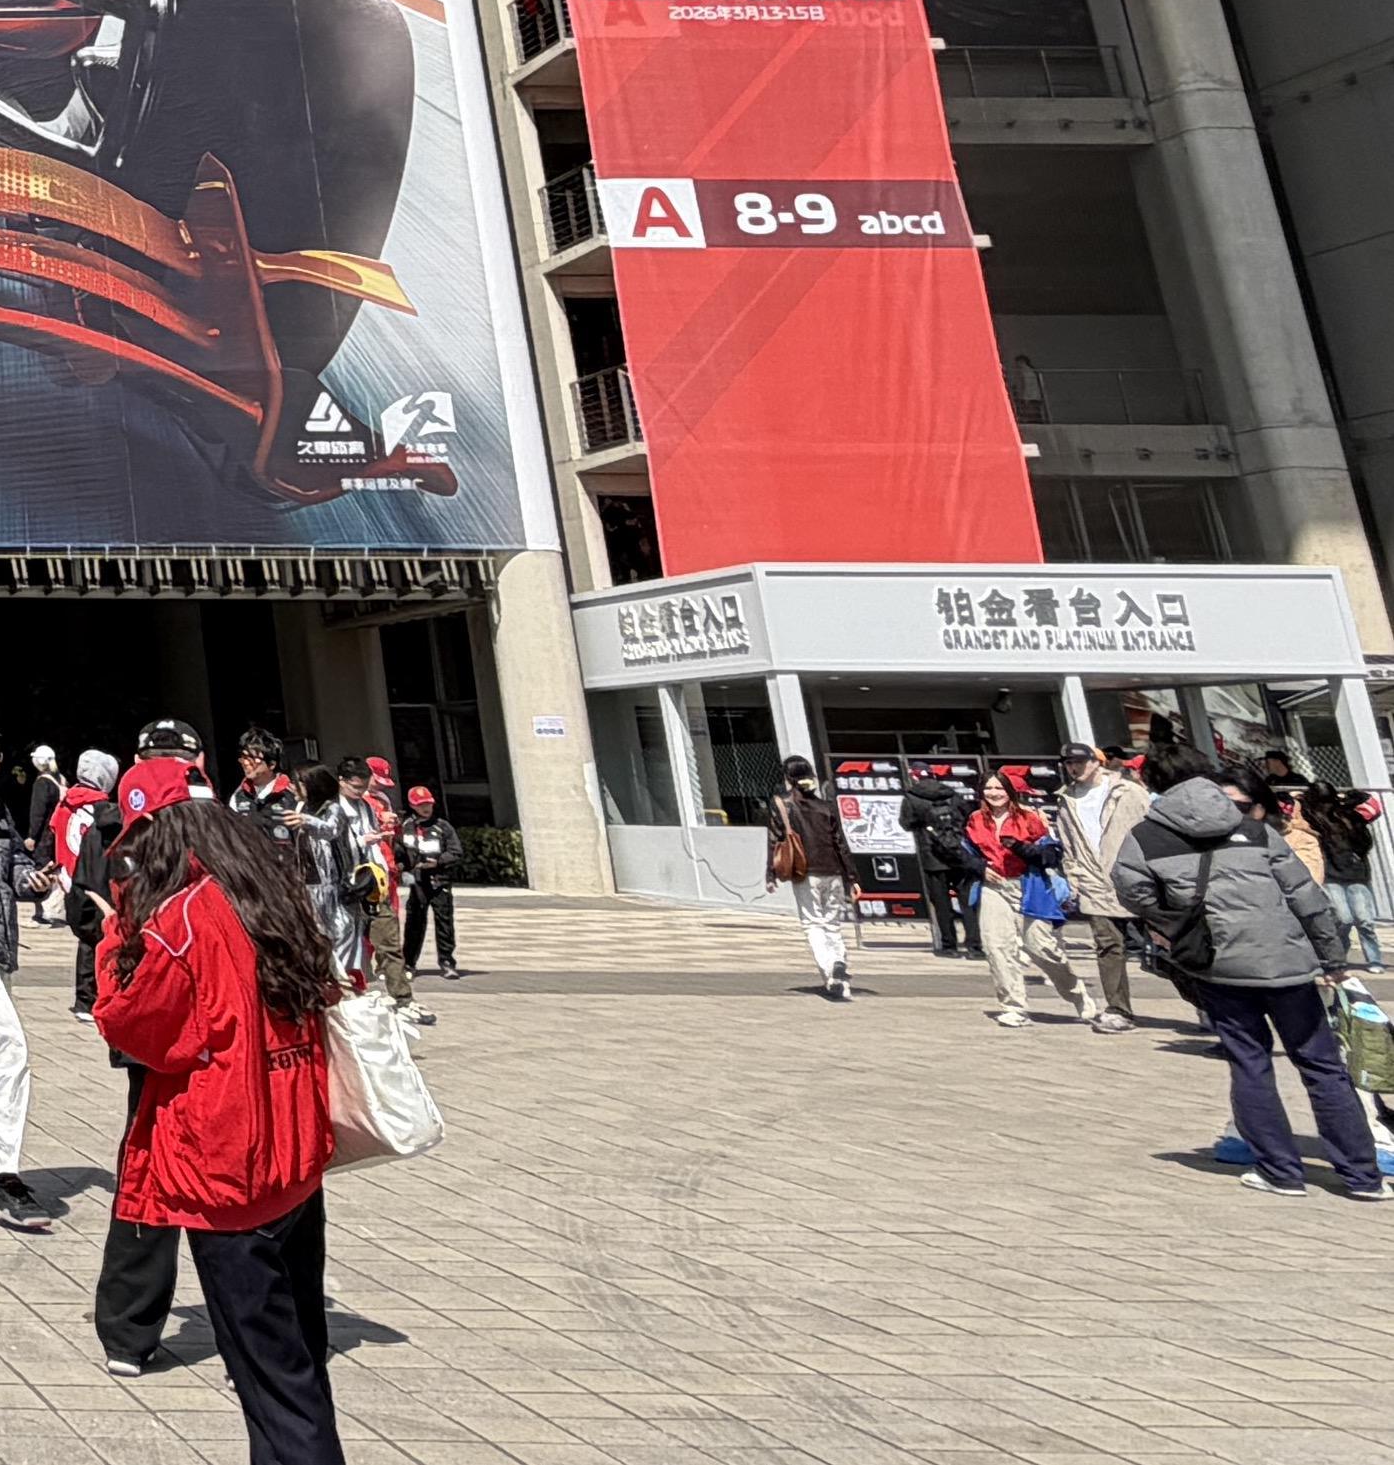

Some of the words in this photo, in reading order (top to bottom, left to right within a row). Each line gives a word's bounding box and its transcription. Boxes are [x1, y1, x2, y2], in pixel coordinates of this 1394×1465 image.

[669, 5, 826, 21] 2026年3月13-15日
[632, 185, 693, 238] A
[733, 192, 838, 234] 8-9
[858, 210, 946, 235] abcd
[935, 587, 1190, 627] 铂金看台入口
[1046, 629, 1117, 651] PLATINUM
[1122, 630, 1196, 651] ENTRANCE
